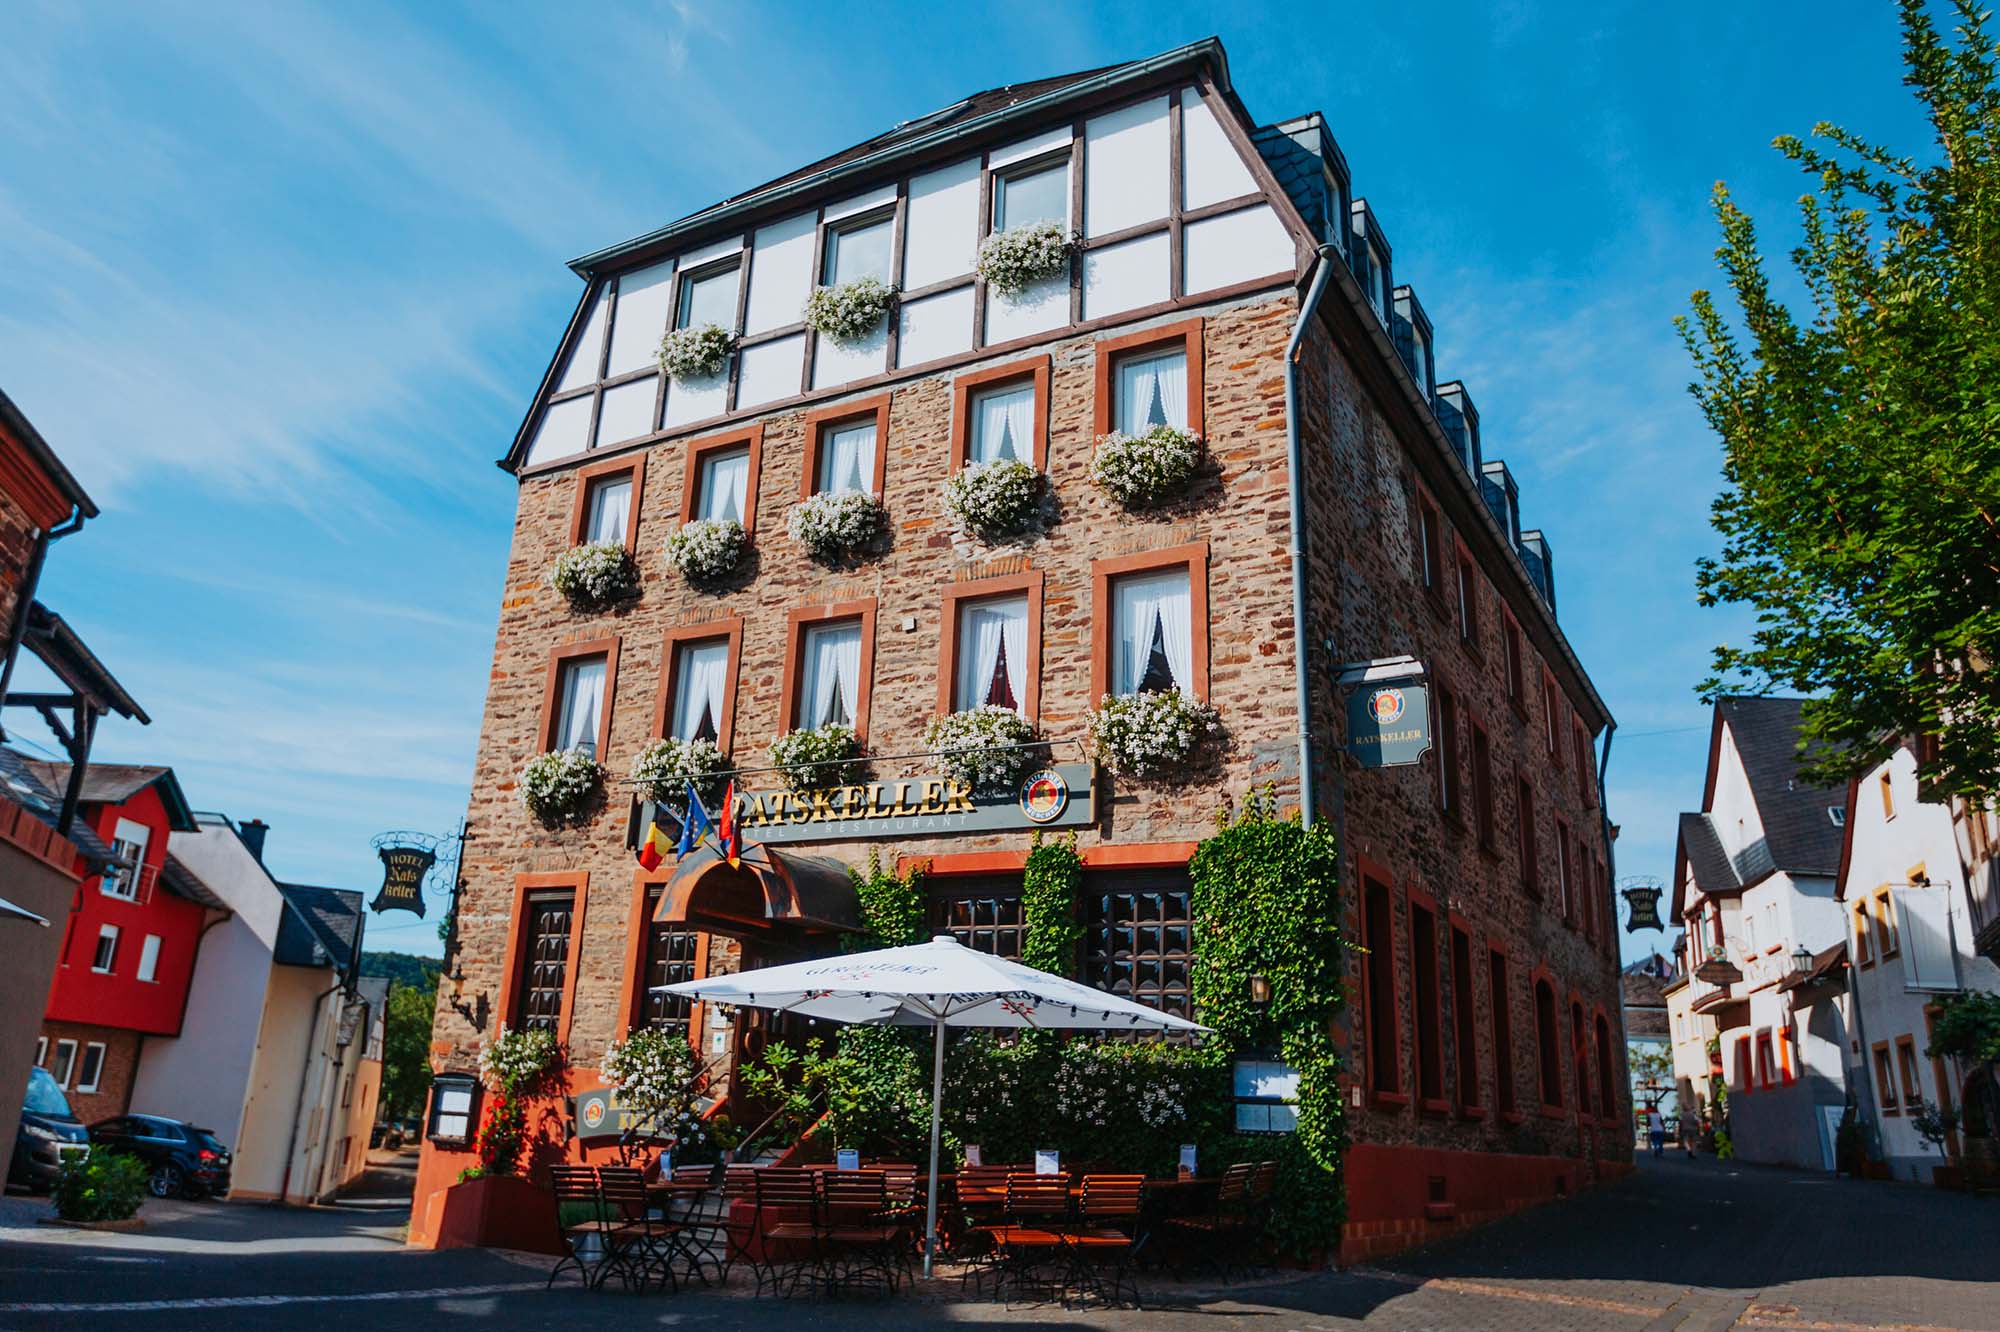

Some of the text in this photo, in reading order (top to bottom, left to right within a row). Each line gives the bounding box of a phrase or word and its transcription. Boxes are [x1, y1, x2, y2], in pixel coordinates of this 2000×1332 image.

[1356, 730, 1422, 745] RATSKELLER
[1024, 772, 1063, 791] PAULANER
[740, 815, 968, 840] OTEL RESTAURANT
[390, 854, 424, 869] HOTEL
